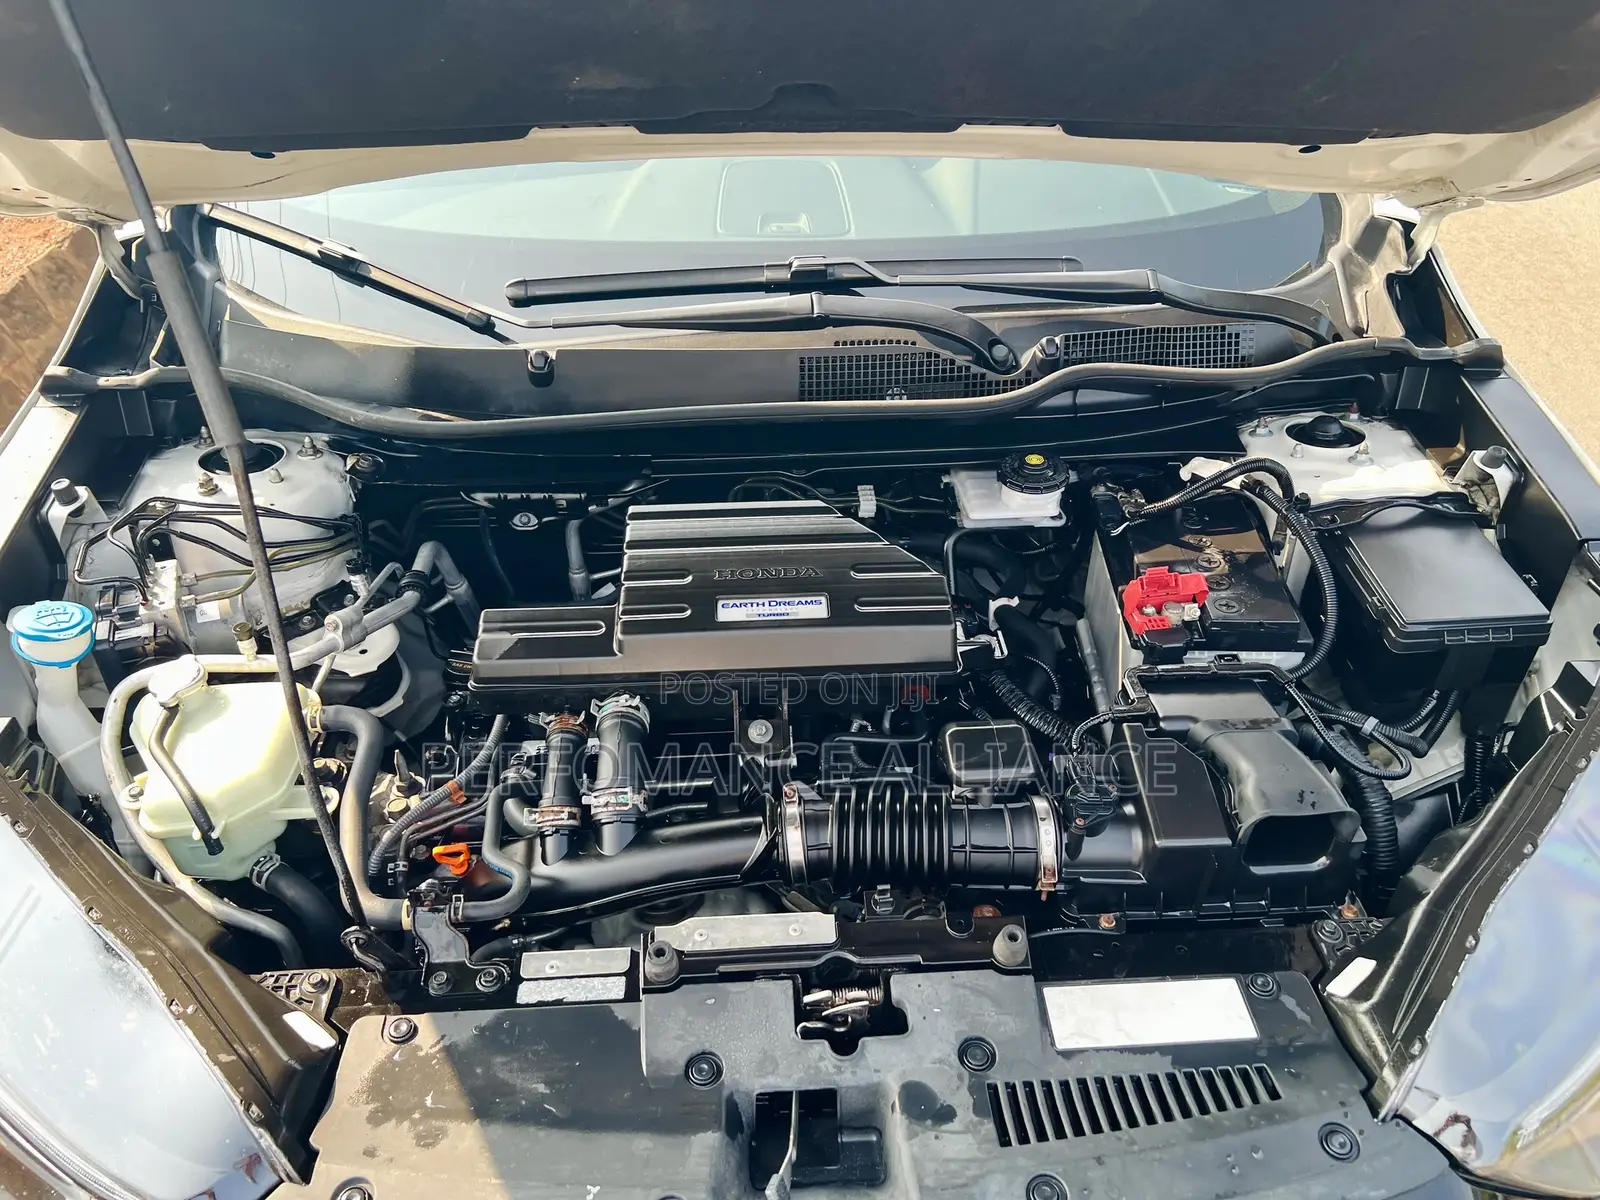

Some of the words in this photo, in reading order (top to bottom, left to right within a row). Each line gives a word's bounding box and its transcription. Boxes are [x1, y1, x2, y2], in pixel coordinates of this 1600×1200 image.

[714, 566, 823, 580] HONDA
[721, 601, 765, 609] EARTH
[768, 599, 822, 607] DREAMS
